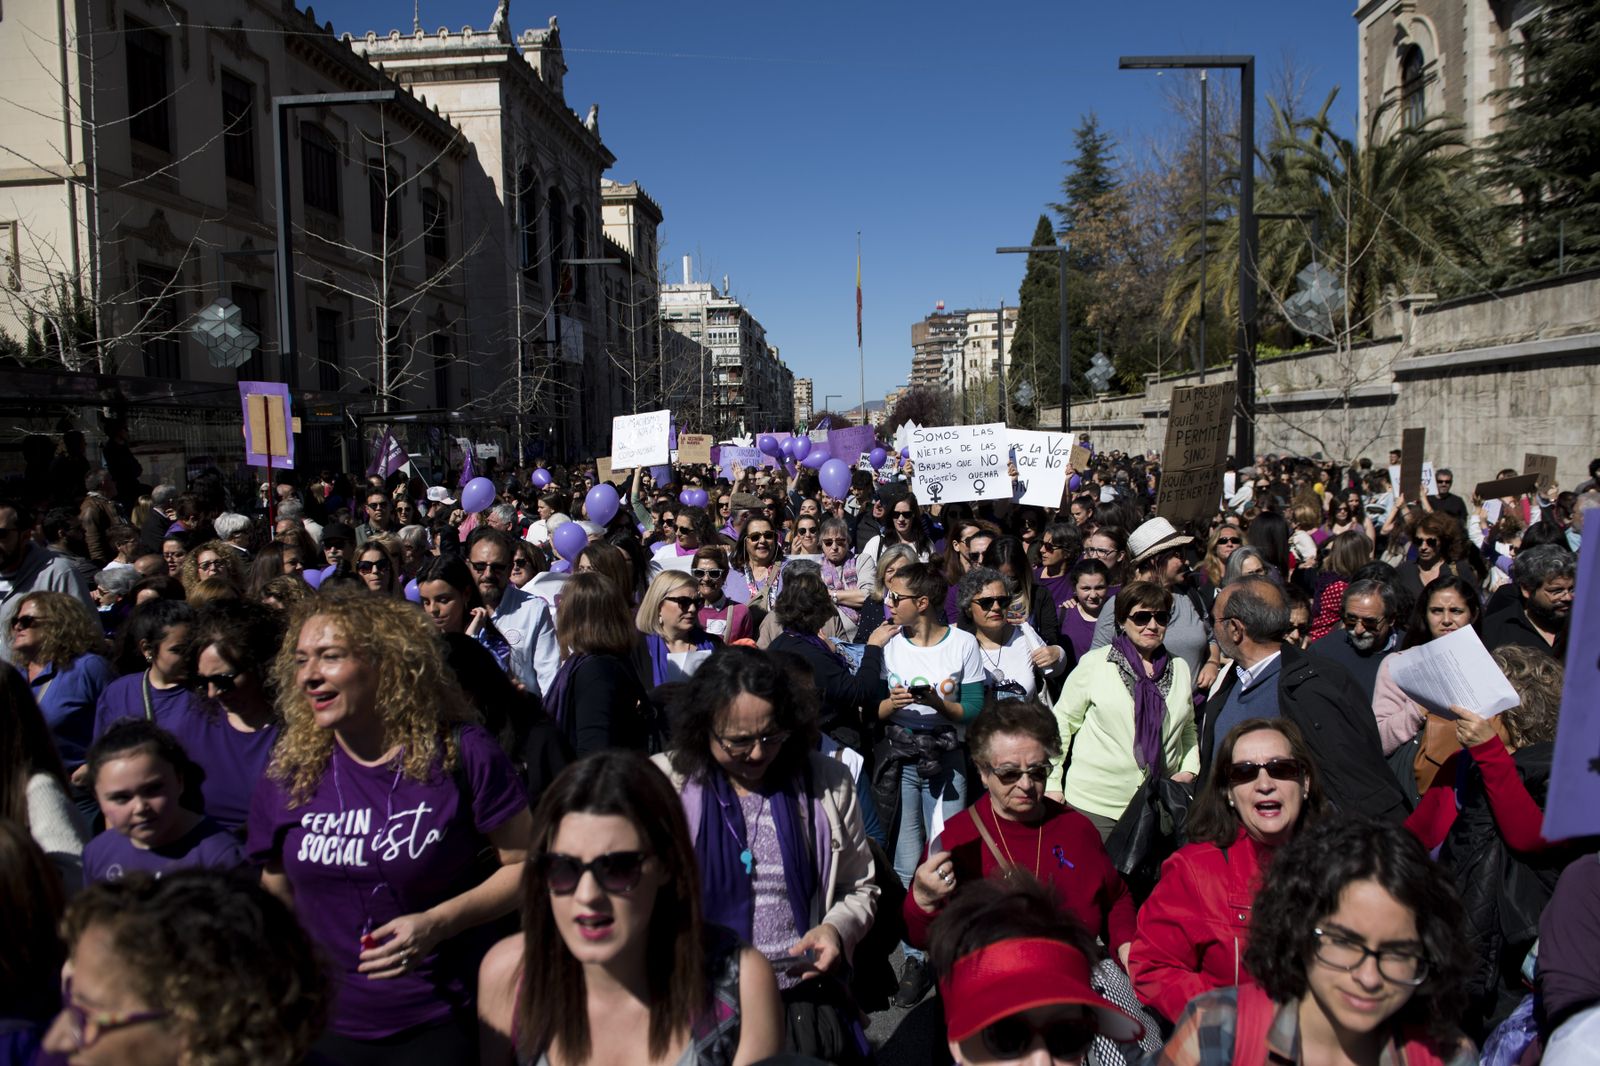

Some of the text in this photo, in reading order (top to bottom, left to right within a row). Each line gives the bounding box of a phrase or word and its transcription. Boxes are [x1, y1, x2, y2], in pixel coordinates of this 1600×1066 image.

[1180, 383, 1235, 404] LA PREGUNTA
[1193, 398, 1218, 413] NO ES
[1206, 411, 1214, 423] TE
[913, 428, 994, 444] SOMOS LAS
[960, 444, 972, 453] DE
[980, 442, 997, 451] LAS
[1029, 443, 1042, 454] LA
[918, 454, 999, 472] BRUJAS QUE NO
[1019, 456, 1039, 467] QUE
[1045, 455, 1061, 469] NO
[968, 470, 999, 480] QUEMAR
[1200, 470, 1210, 482] VA
[301, 808, 372, 835] FEMIN
[297, 832, 369, 867] SOCIAL
